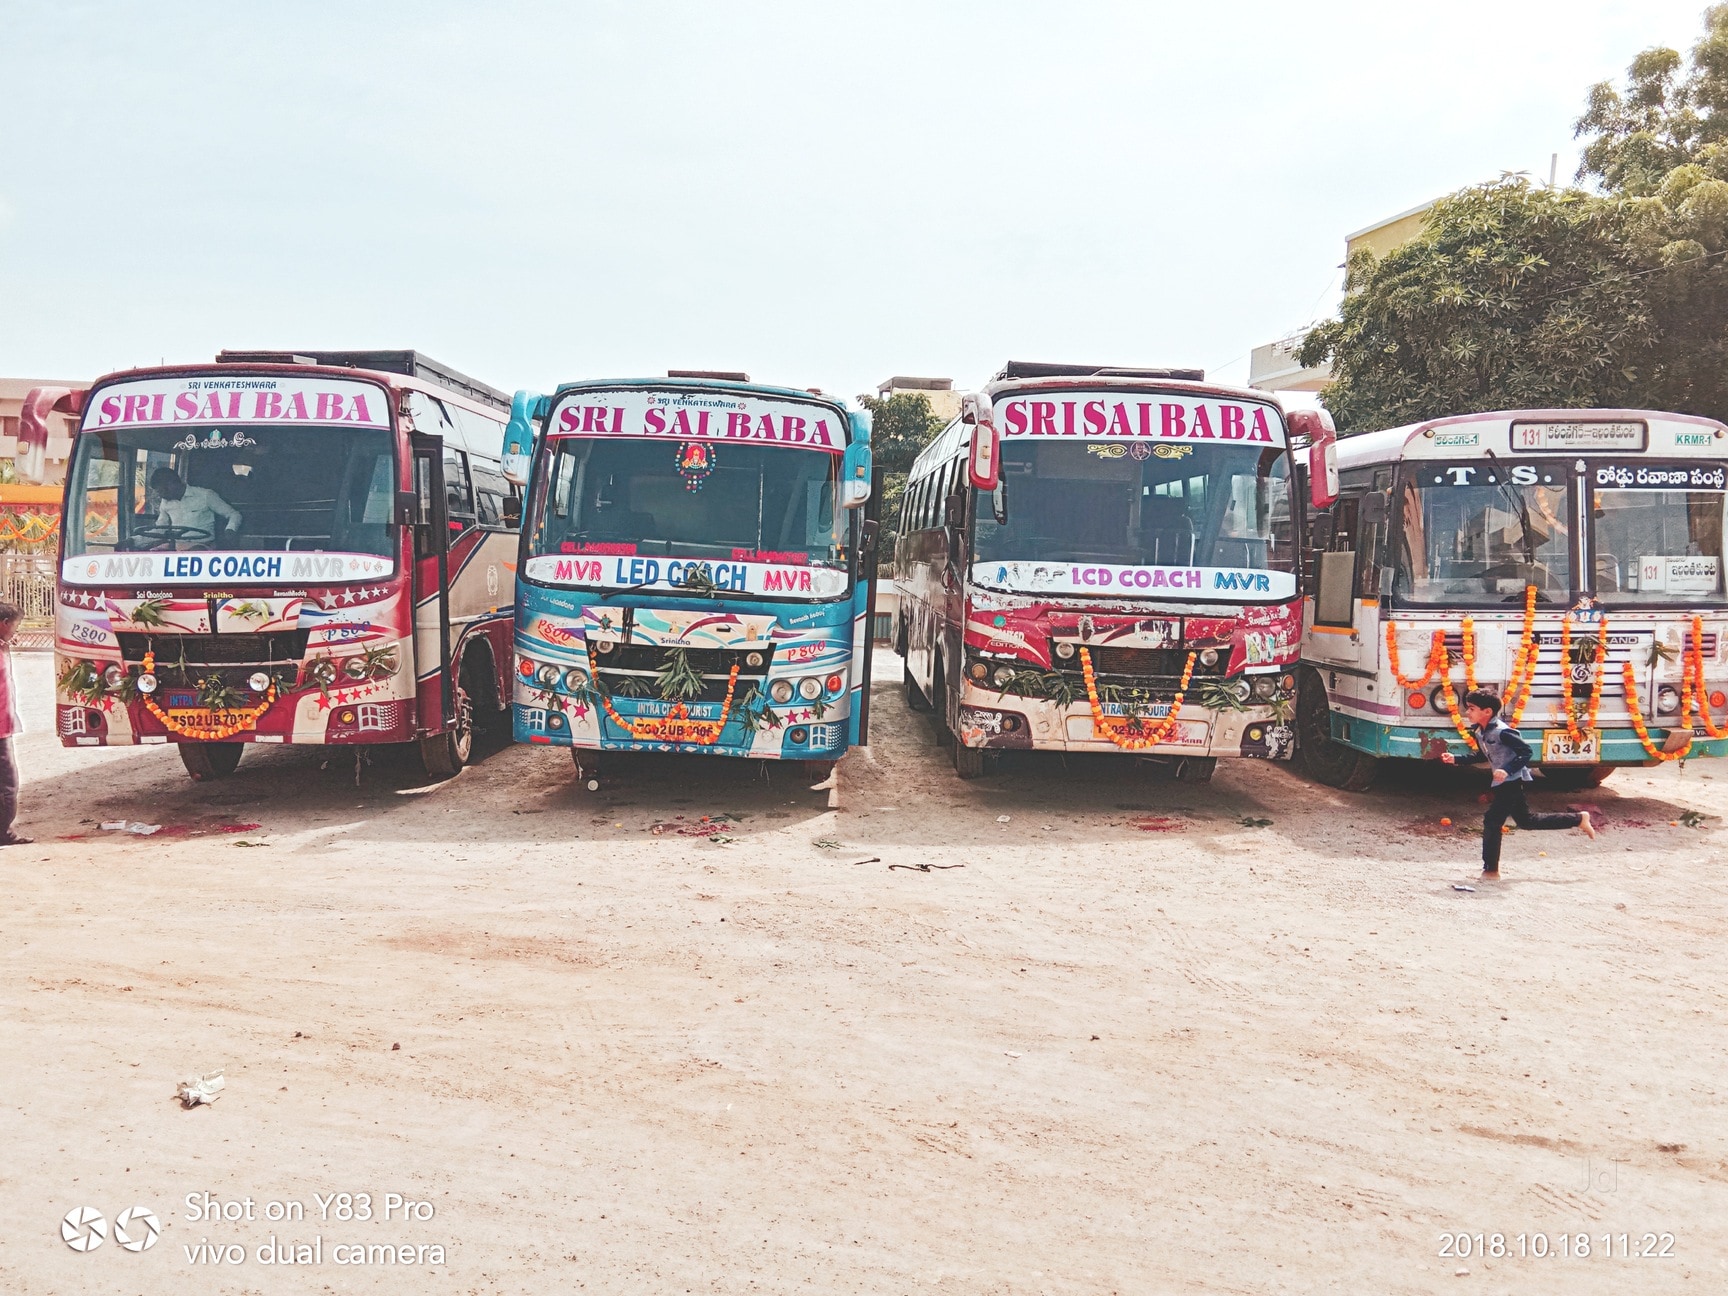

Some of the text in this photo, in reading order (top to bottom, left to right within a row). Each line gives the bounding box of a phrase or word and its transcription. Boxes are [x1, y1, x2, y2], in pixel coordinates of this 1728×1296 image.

[188, 381, 277, 390] SRI VENKATESHWARA
[98, 390, 373, 426] SRI SAI BABA
[558, 405, 835, 447] SRI SAI BABA
[1004, 399, 1274, 443] SRI SAI BABA
[1522, 429, 1541, 446] 131
[1676, 434, 1711, 444] KRMR-1
[163, 557, 204, 577] LED
[208, 557, 281, 578] COACH
[554, 558, 811, 592] MVR LED COACH MVR
[1644, 565, 1658, 580] 131
[1072, 567, 1271, 592] LCD COACH MVR
[637, 703, 660, 715] INTRA
[1101, 703, 1122, 715] NTRA
